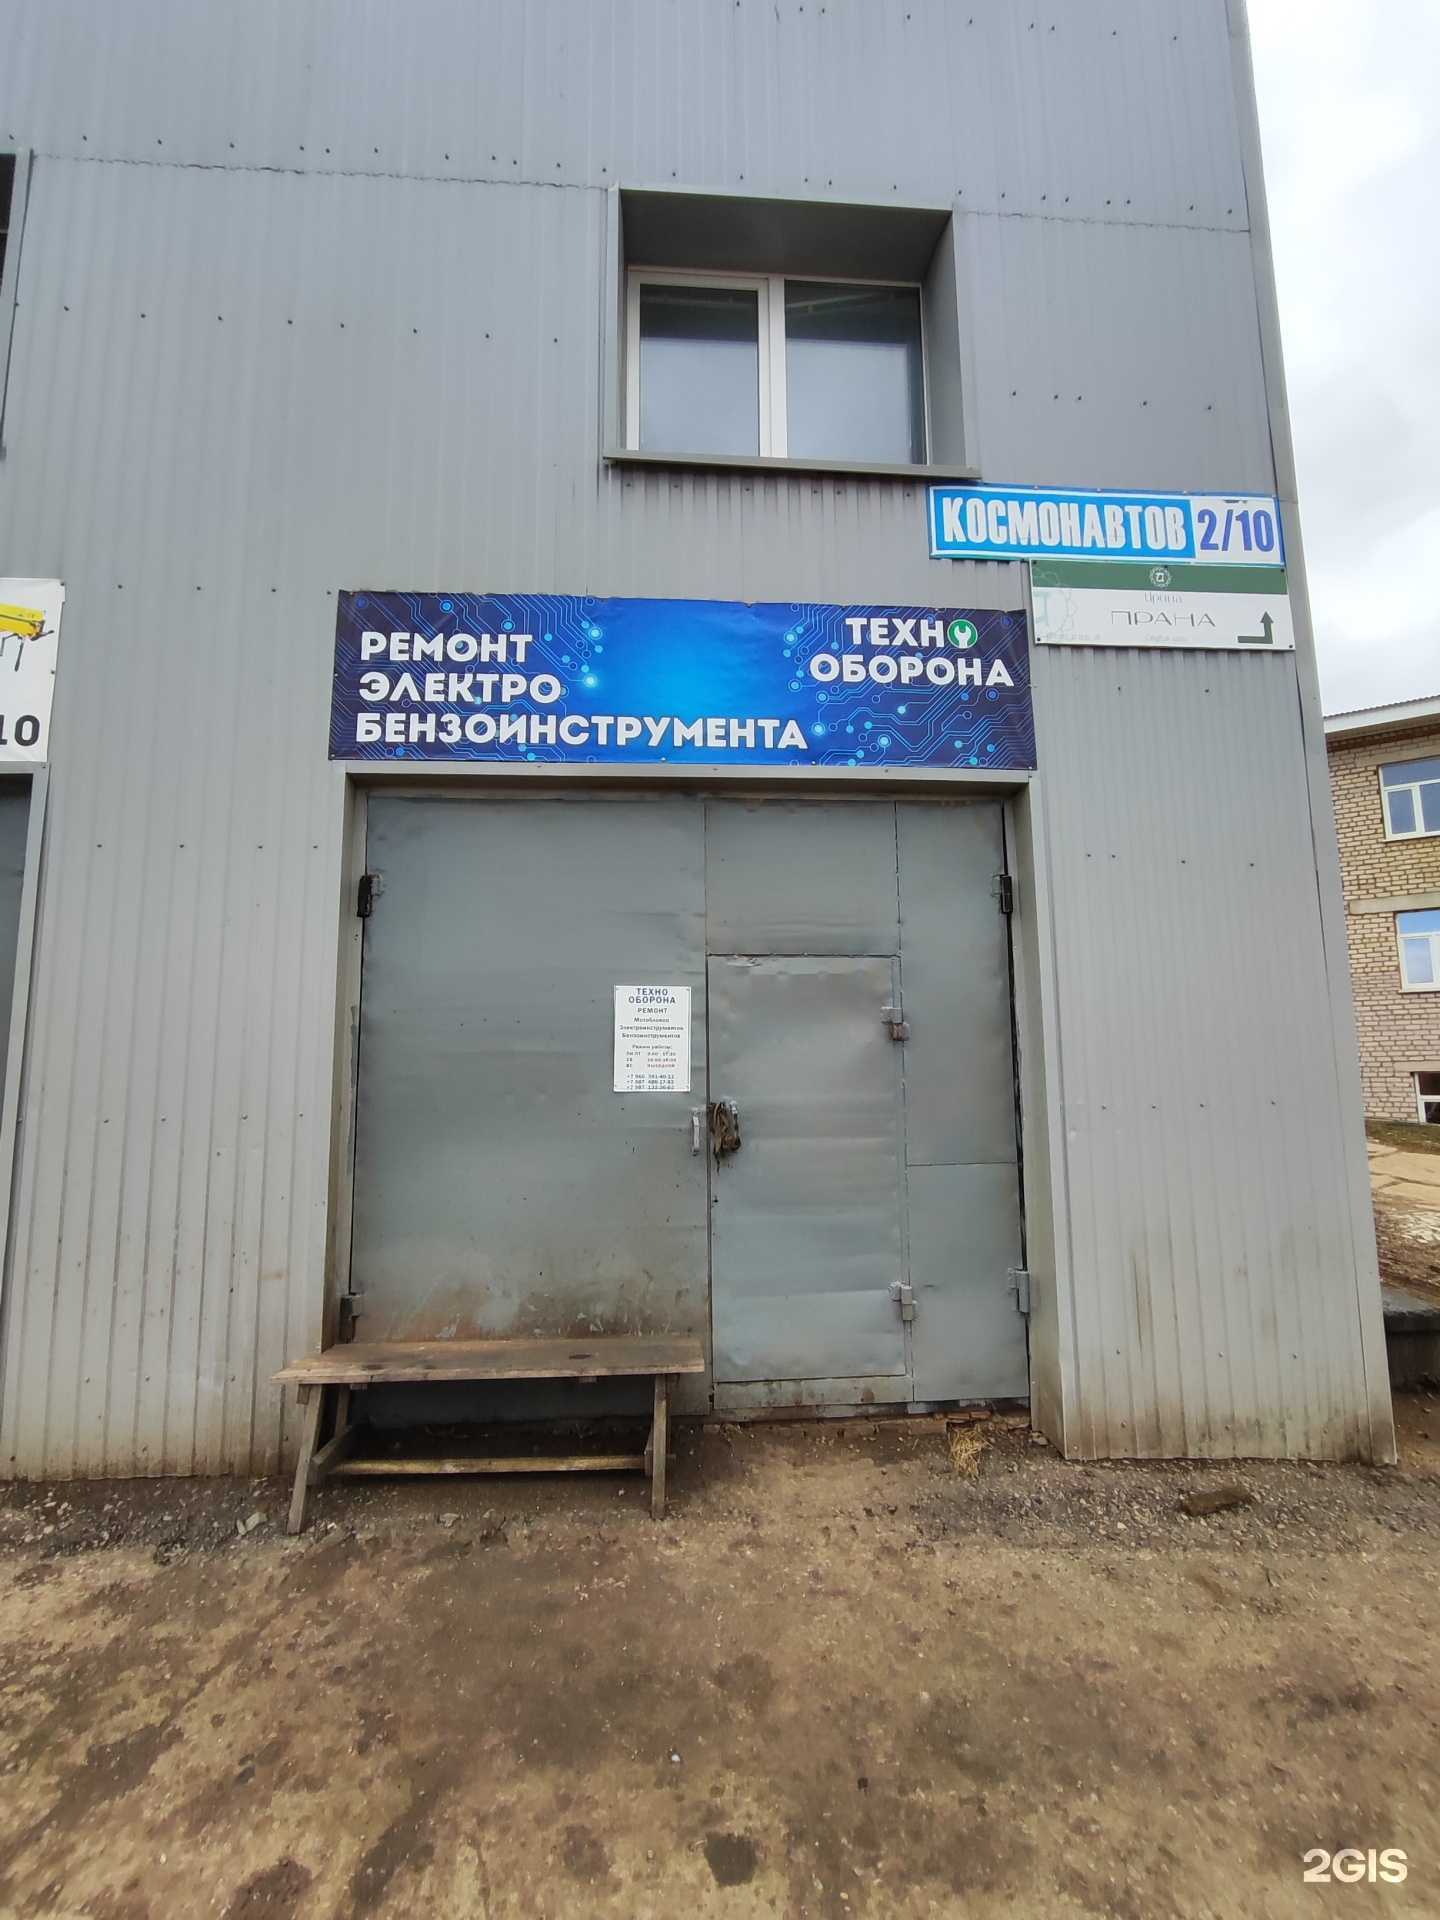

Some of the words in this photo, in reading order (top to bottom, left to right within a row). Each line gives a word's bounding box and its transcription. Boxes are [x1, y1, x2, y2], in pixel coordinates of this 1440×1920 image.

[942, 496, 1186, 550] КОСМОНАВТОВ
[1198, 509, 1275, 552] 2/10
[360, 631, 532, 662] РЕМОНТ
[809, 653, 1014, 687] ОБОРОНА
[358, 671, 562, 704] ЭЛЕКТРО
[355, 712, 808, 750] БЕНЗОИНСТРУМЕНТА
[628, 995, 676, 1004] ОБОРОНА
[636, 987, 669, 996] ТЕХНО
